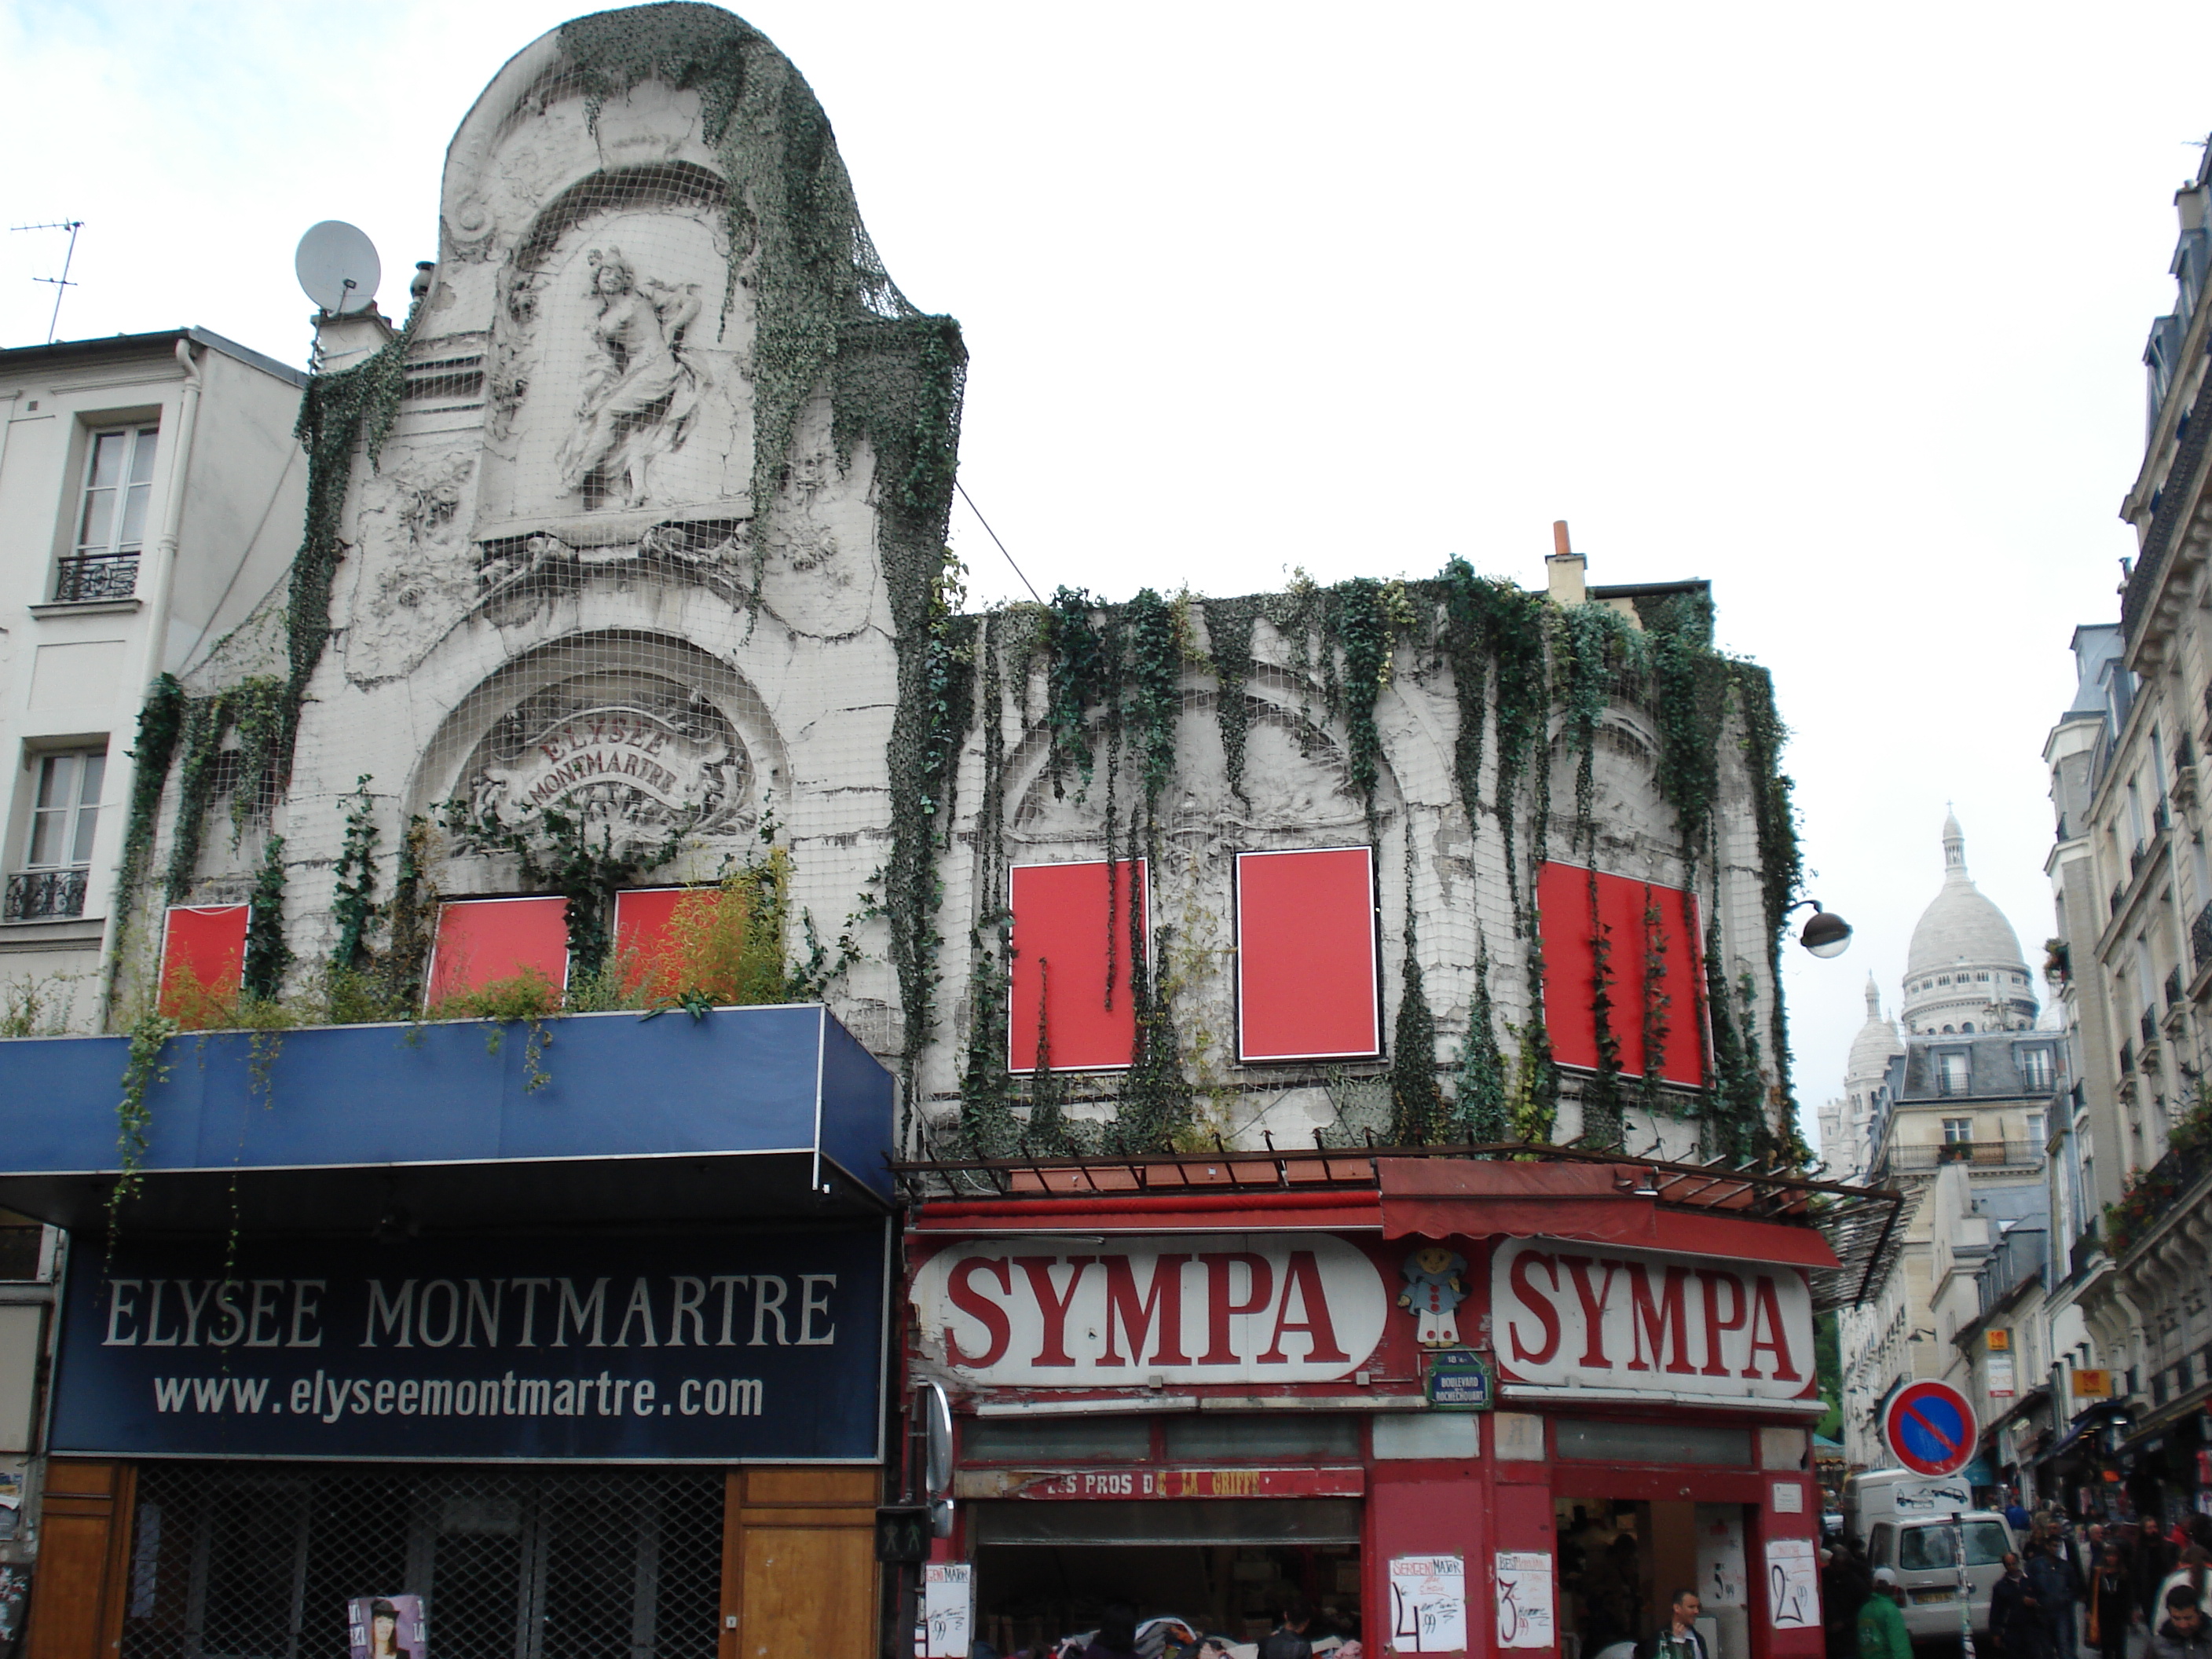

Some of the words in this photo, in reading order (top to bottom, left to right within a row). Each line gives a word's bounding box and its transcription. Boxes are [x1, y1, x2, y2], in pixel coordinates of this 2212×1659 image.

[529, 750, 677, 806] MONTMARTRE
[101, 1278, 327, 1347] ELYSEE
[359, 1274, 837, 1348] MONTMARTRE
[947, 1251, 1351, 1369] SYMPA
[1509, 1250, 1802, 1382] SYMPA
[154, 1370, 763, 1423] www.elyseemontmartre.com
[1436, 1390, 1483, 1401] ROCHECHOUART
[1441, 1376, 1478, 1388] BOULEVARD
[1085, 1474, 1133, 1495] PROS
[1182, 1471, 1199, 1495] LA
[1211, 1471, 1260, 1496] GRIFFE
[1498, 1577, 1518, 1643] 3
[1771, 1564, 1804, 1624] 2
